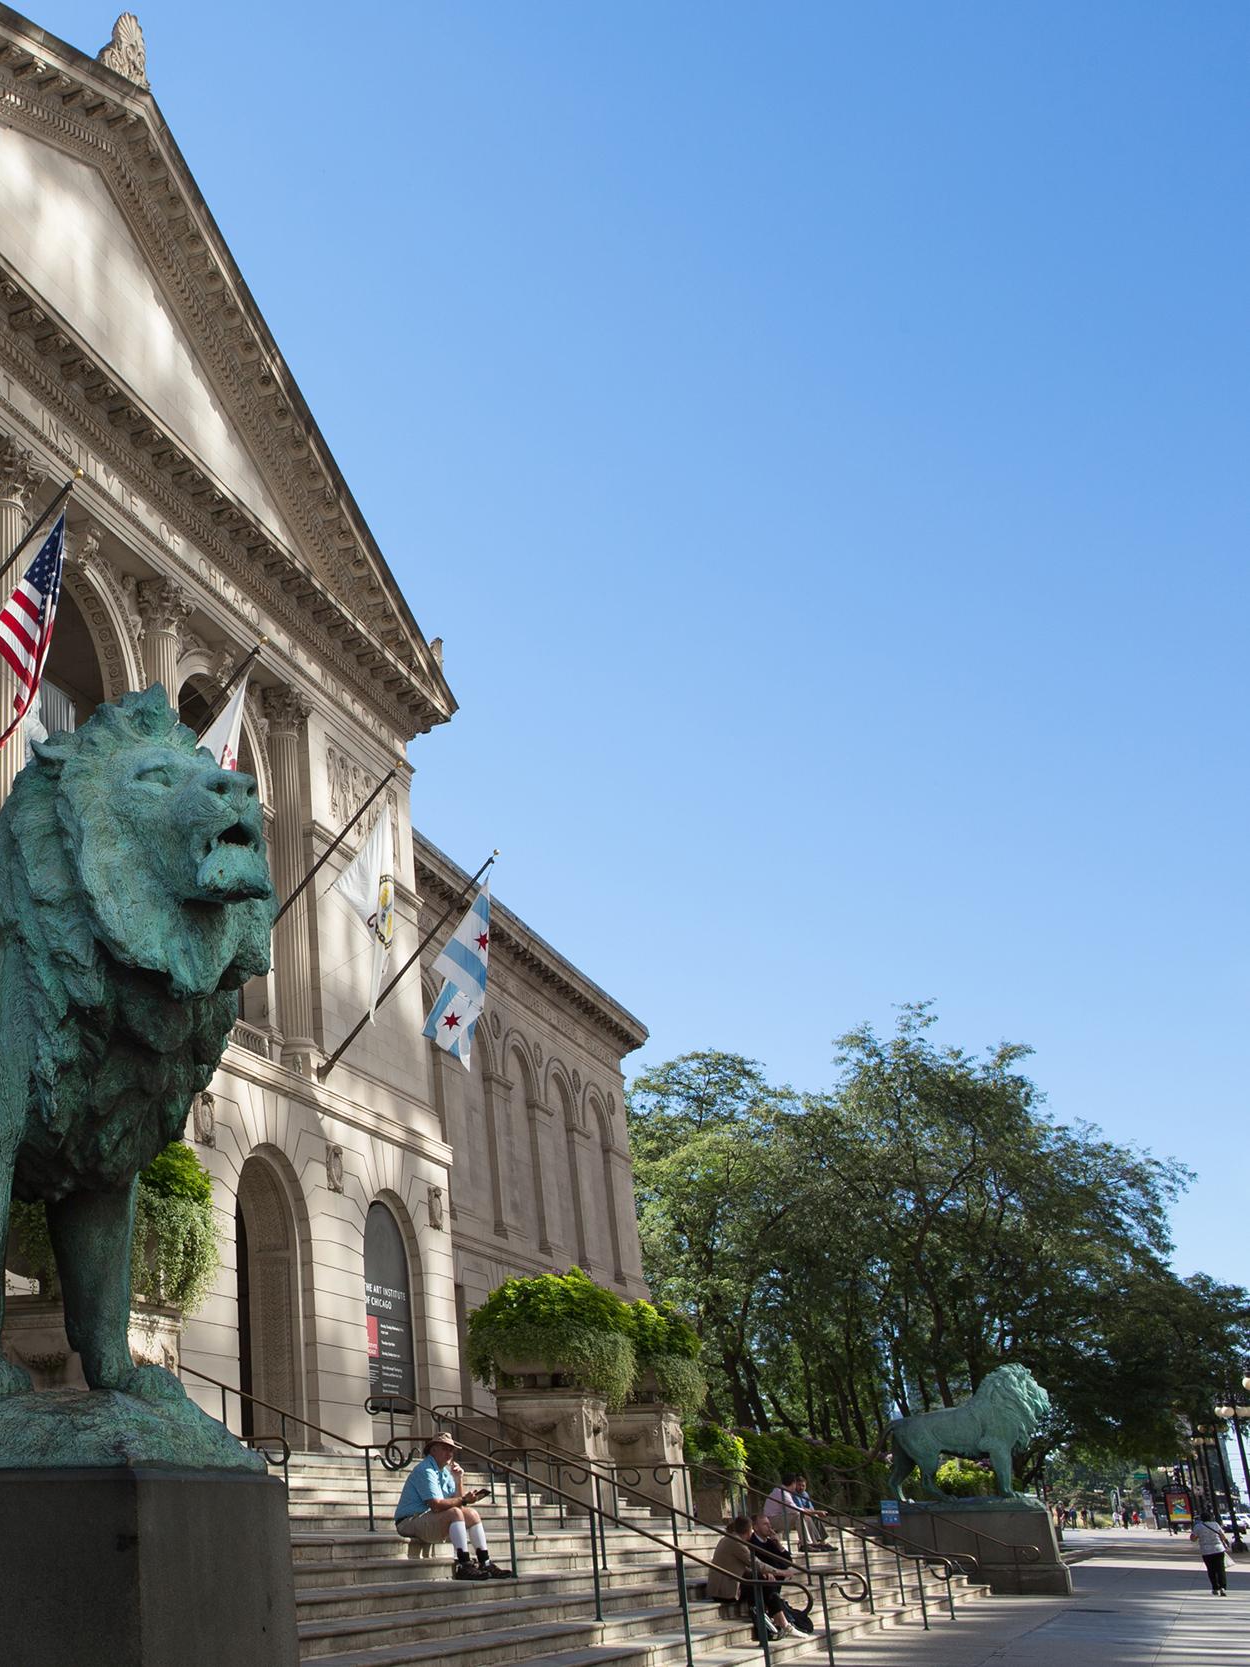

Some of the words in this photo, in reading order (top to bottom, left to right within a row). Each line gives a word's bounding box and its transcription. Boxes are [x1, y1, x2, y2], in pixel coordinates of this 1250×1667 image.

[40, 409, 139, 518] INSTITVTE
[159, 521, 182, 552] OF
[198, 557, 260, 626] CHICAGO
[373, 1284, 382, 1295] ART
[371, 1296, 392, 1310] CHICAGO
